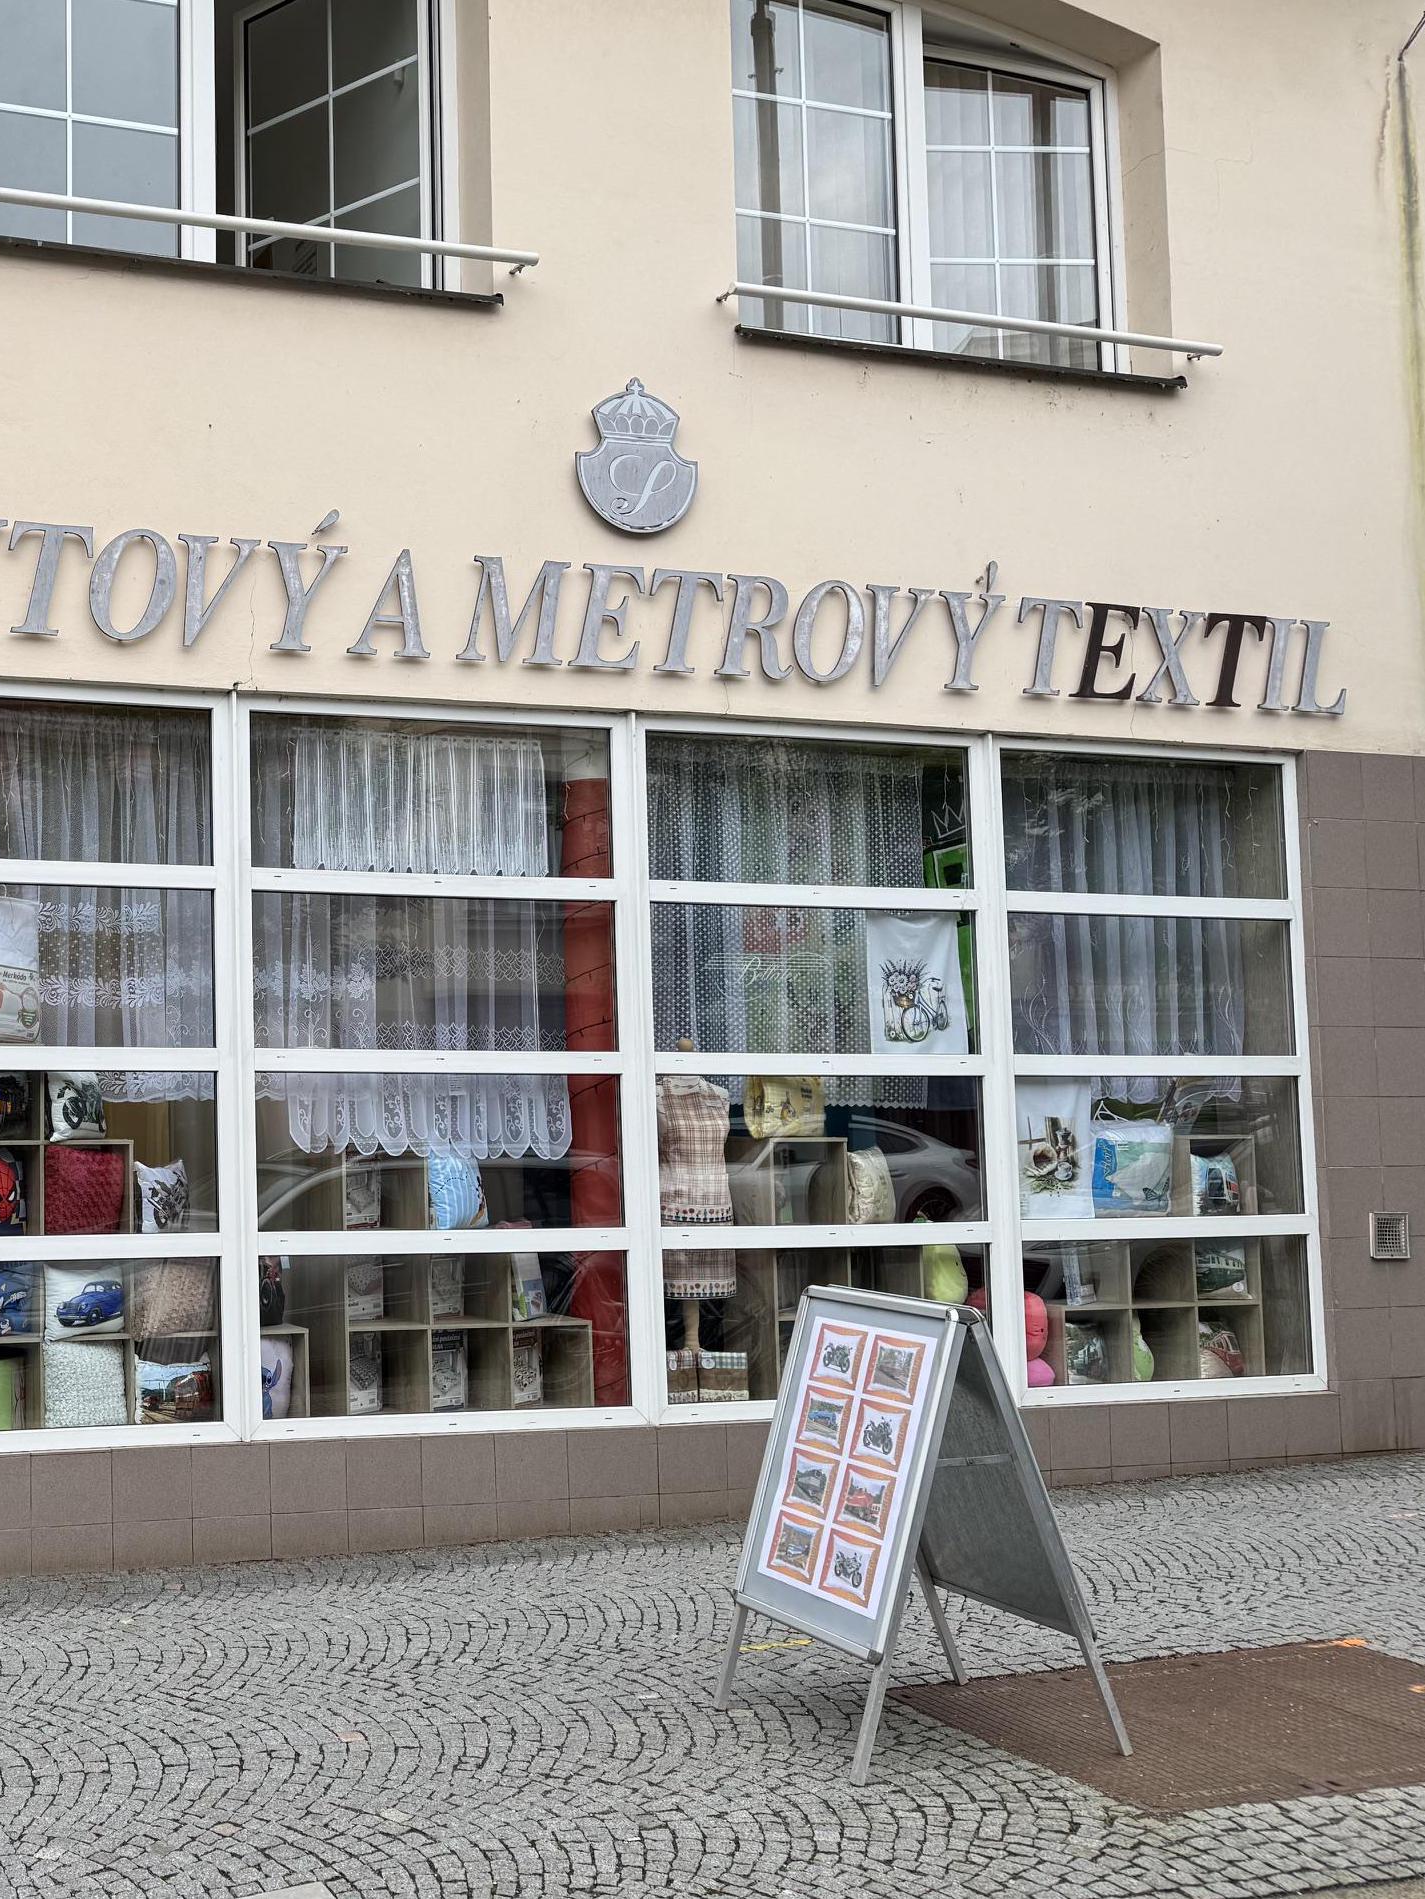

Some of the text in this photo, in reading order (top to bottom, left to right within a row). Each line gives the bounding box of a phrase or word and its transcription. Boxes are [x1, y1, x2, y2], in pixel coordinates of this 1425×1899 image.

[346, 548, 432, 660] A
[455, 553, 1007, 692] METROVÝ
[1018, 595, 1347, 716] TEXTIL
